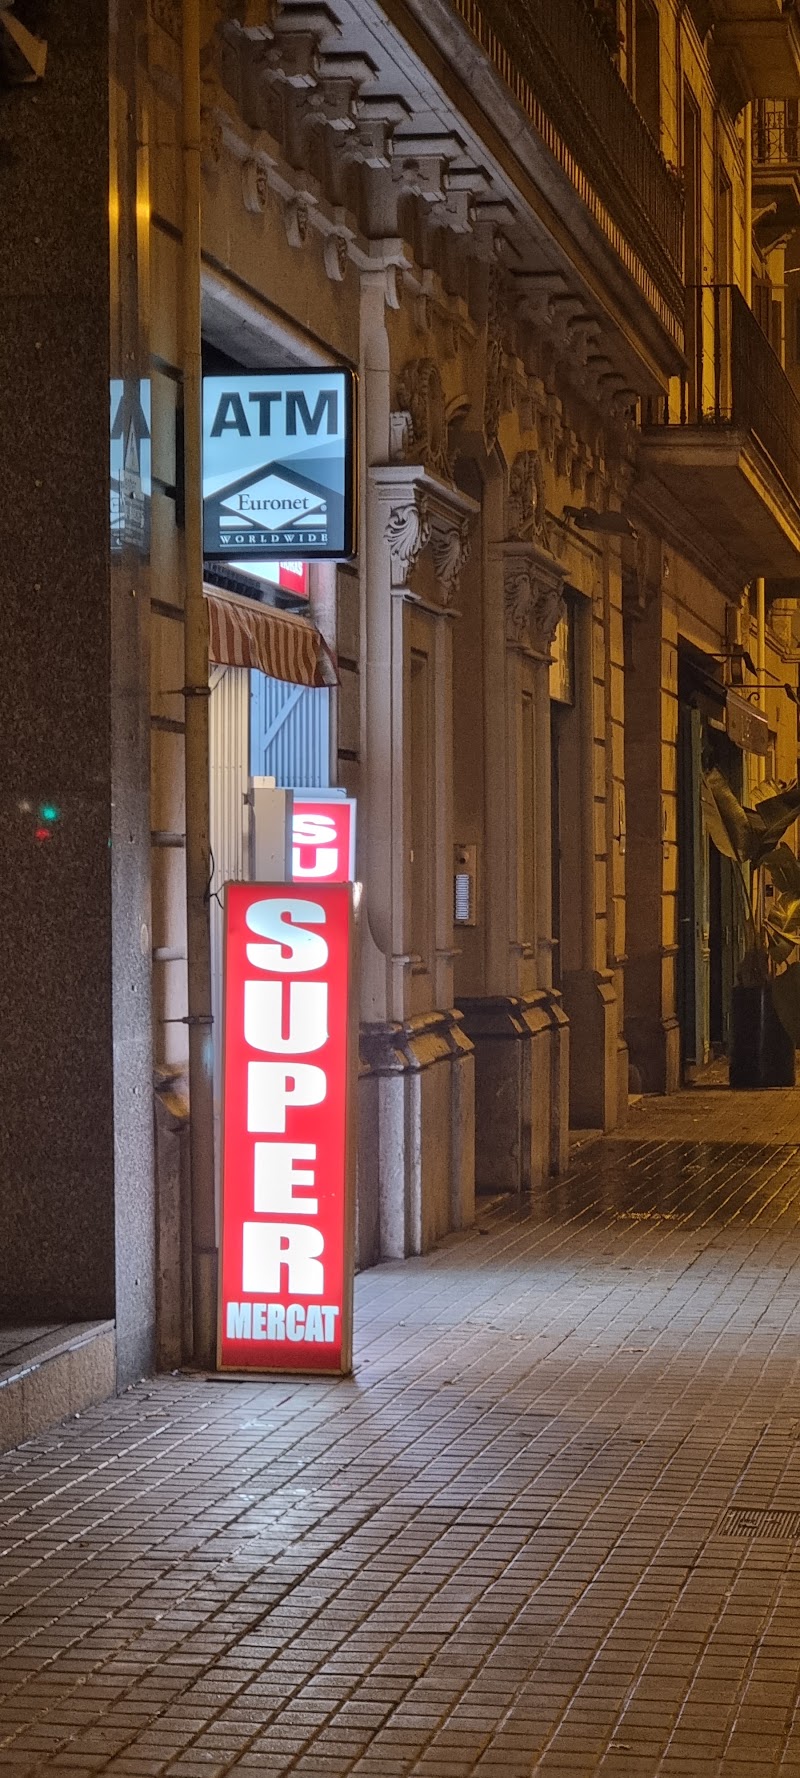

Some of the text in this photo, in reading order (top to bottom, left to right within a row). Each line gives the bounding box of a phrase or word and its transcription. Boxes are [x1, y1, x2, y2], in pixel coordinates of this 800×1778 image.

[210, 390, 338, 437] ATM
[236, 493, 310, 511] Euronet
[220, 533, 328, 543] WORLDWIDE
[244, 898, 329, 1295] SUPER
[226, 1302, 339, 1343] MERCAT
